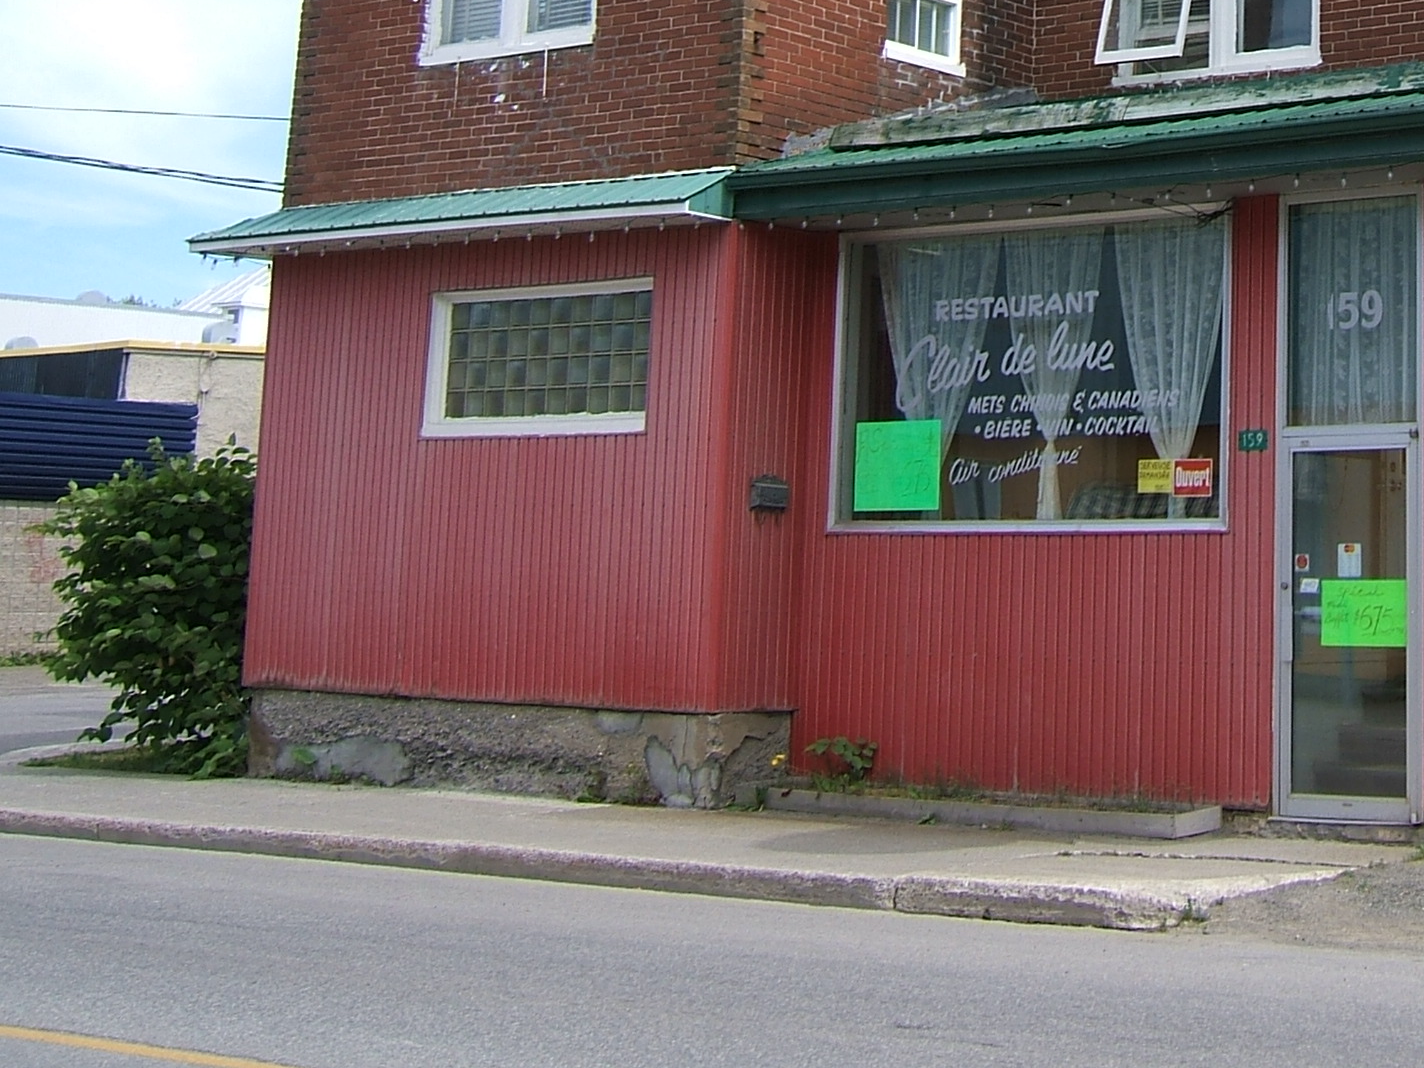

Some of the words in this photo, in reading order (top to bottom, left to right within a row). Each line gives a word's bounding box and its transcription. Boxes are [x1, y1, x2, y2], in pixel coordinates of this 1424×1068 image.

[935, 290, 1100, 322] RESTAURANT
[1327, 290, 1383, 330] 159
[895, 334, 991, 413] Clair
[1001, 333, 1037, 376] de
[1047, 320, 1115, 371] lune
[968, 395, 1006, 415] METS
[1010, 393, 1070, 413] CHINOIS
[1073, 389, 1086, 415] &
[1087, 389, 1180, 412] CANADIENS
[1045, 417, 1075, 436] VIN
[1084, 415, 1161, 437] COCKTAIL
[1242, 432, 1265, 449] 159
[1175, 466, 1211, 488] Ouvert
